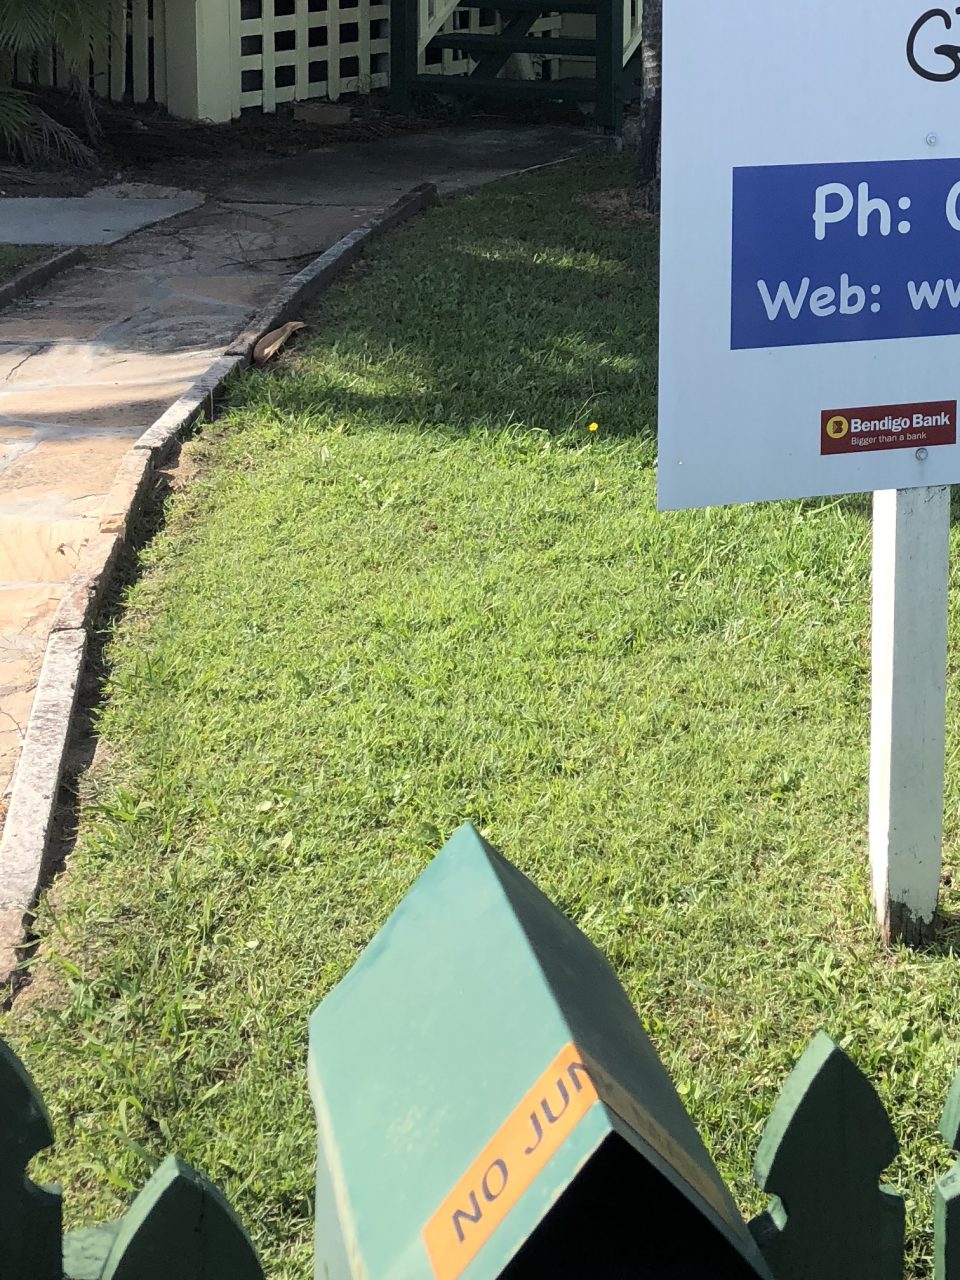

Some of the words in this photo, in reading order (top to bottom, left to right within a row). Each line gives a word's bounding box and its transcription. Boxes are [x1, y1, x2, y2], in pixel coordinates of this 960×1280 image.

[812, 181, 912, 241] Ph:
[757, 273, 881, 321] Web:
[850, 415, 911, 433] Bendigo
[912, 412, 951, 428] Bank
[851, 436, 877, 447] Bigger
[878, 433, 898, 443] than
[906, 431, 928, 441] bank
[450, 1157, 511, 1244] NO
